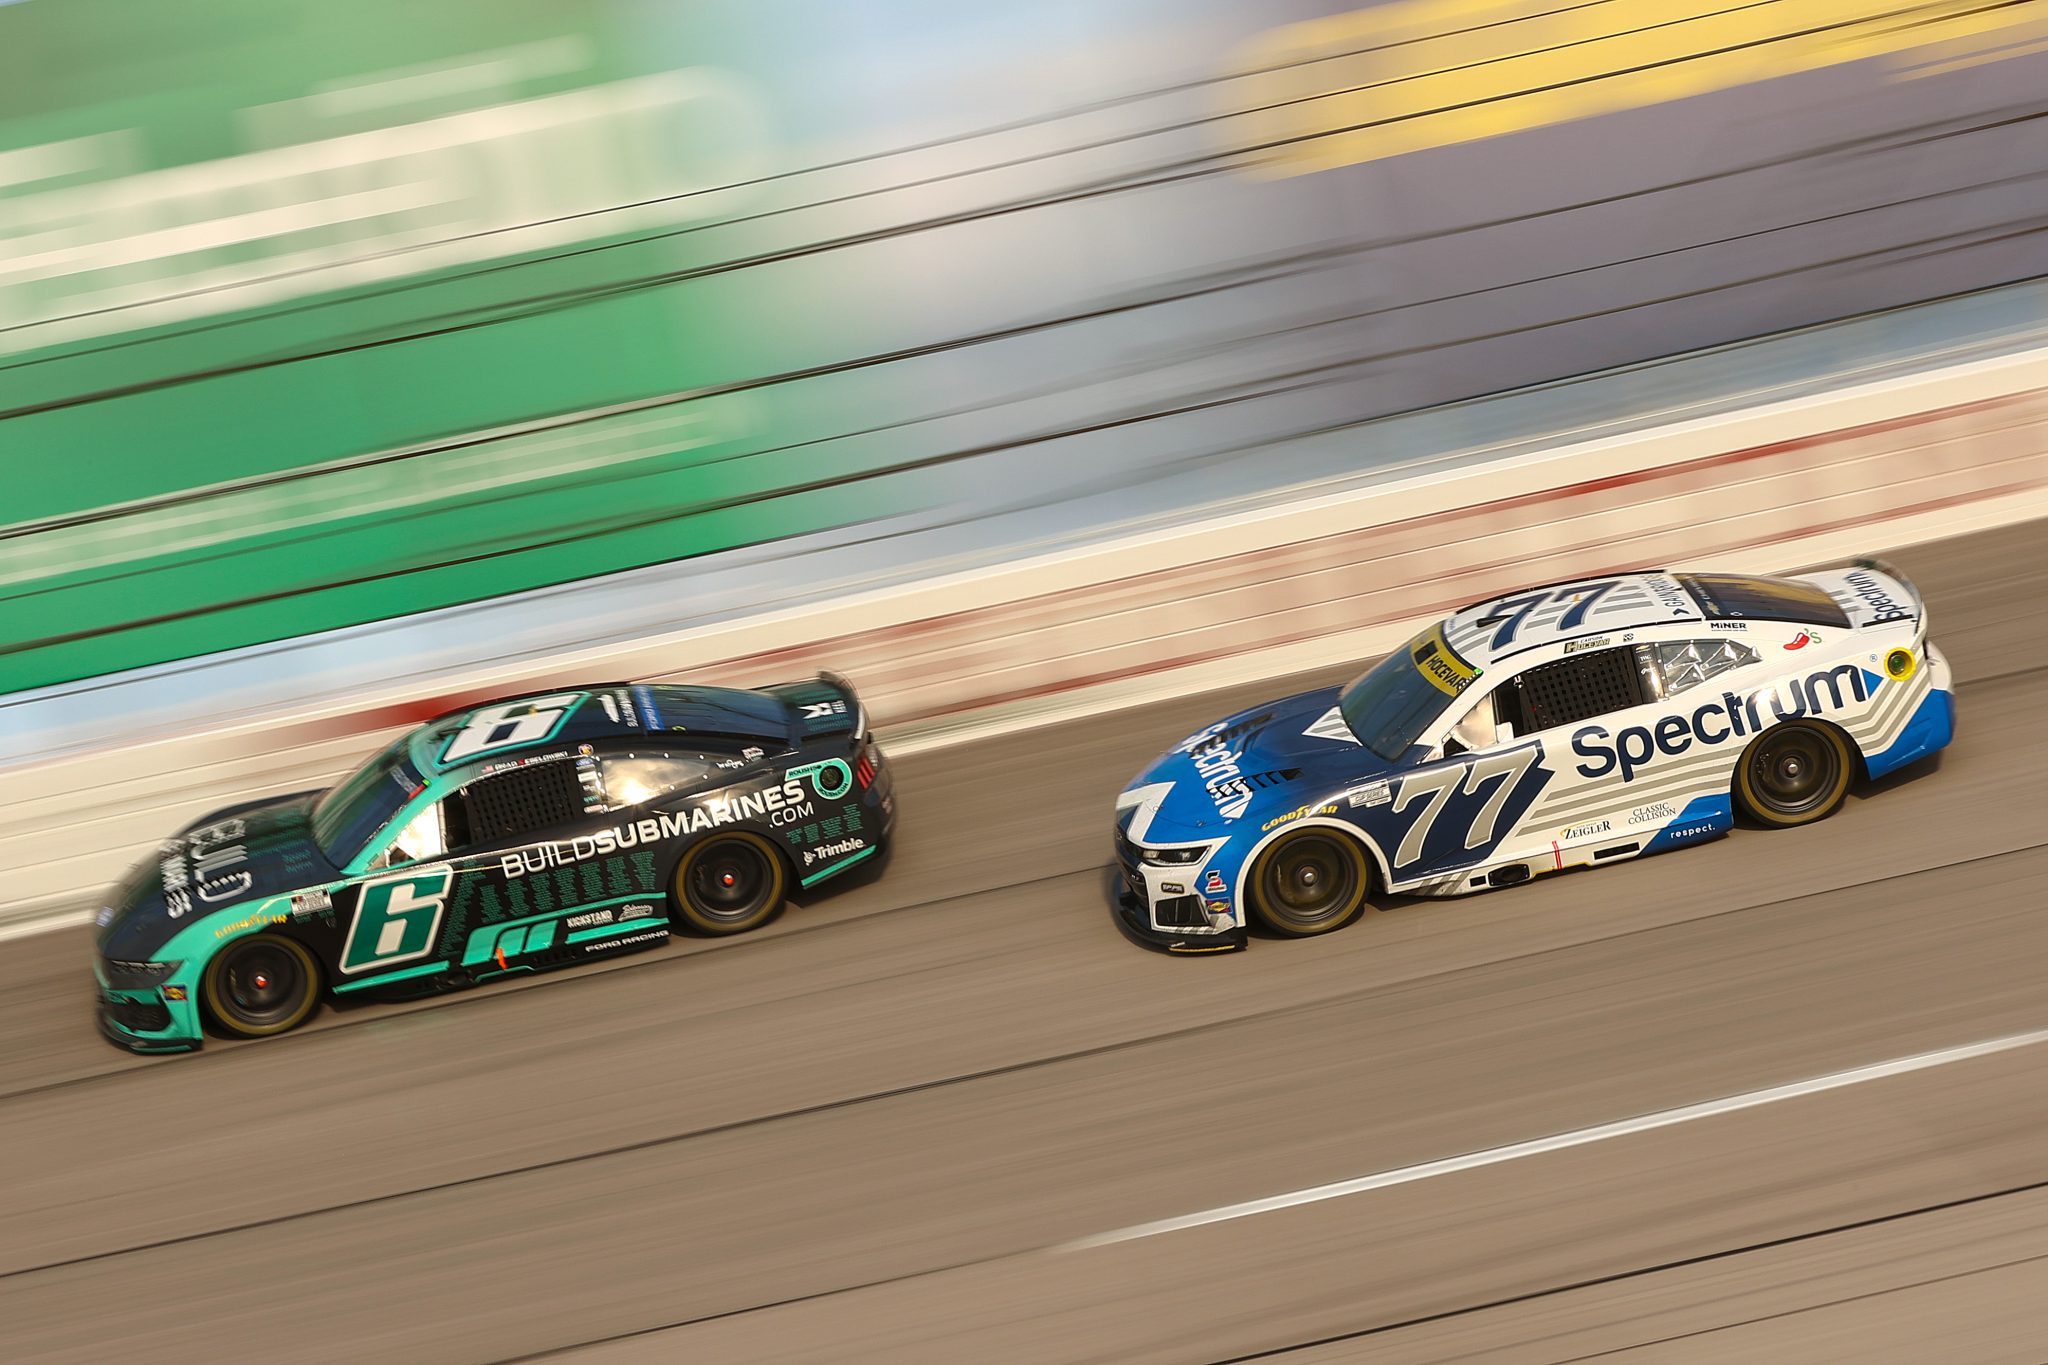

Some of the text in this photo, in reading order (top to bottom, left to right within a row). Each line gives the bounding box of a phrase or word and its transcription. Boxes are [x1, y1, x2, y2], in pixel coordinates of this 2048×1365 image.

[1487, 581, 1622, 651] 77
[1425, 655, 1467, 693] HOCEVAR
[442, 694, 582, 763] 6
[1571, 664, 1867, 783] Spectrum
[769, 801, 814, 829] .COM
[1391, 744, 1539, 869] 77
[1627, 807, 1676, 825] COLLISION
[1632, 802, 1670, 817] CLASSIC
[502, 780, 806, 880] BUILDSUBMARINES
[814, 837, 865, 860] Trimble
[1564, 820, 1612, 840] ZEIGLER
[1670, 823, 1716, 839] respect.
[339, 862, 454, 975] 6
